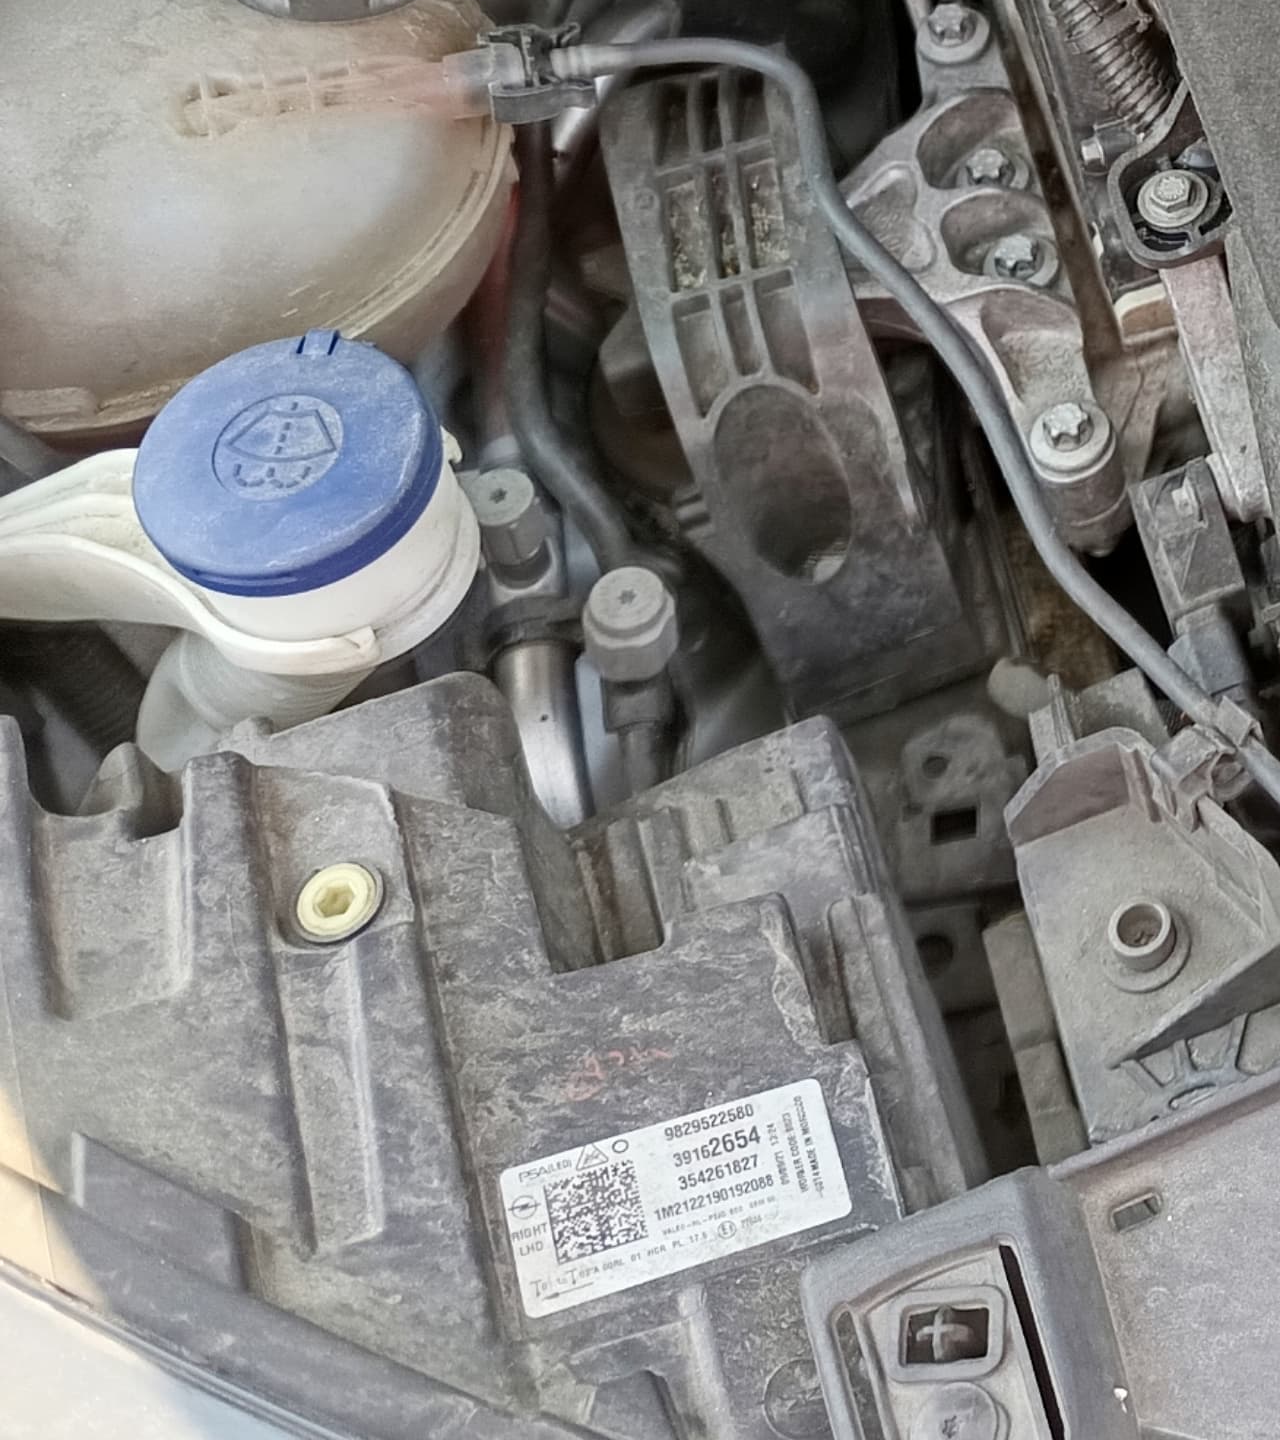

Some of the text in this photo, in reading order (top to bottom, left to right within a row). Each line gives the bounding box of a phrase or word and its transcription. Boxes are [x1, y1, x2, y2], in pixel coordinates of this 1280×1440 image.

[665, 1103, 754, 1141] 9829522580
[672, 1124, 761, 1168] 39162654
[677, 1154, 759, 1191] 354261827
[654, 1174, 774, 1222] 1M2122190192088
[511, 1222, 548, 1241] RIGHT
[518, 1240, 544, 1256] LHD
